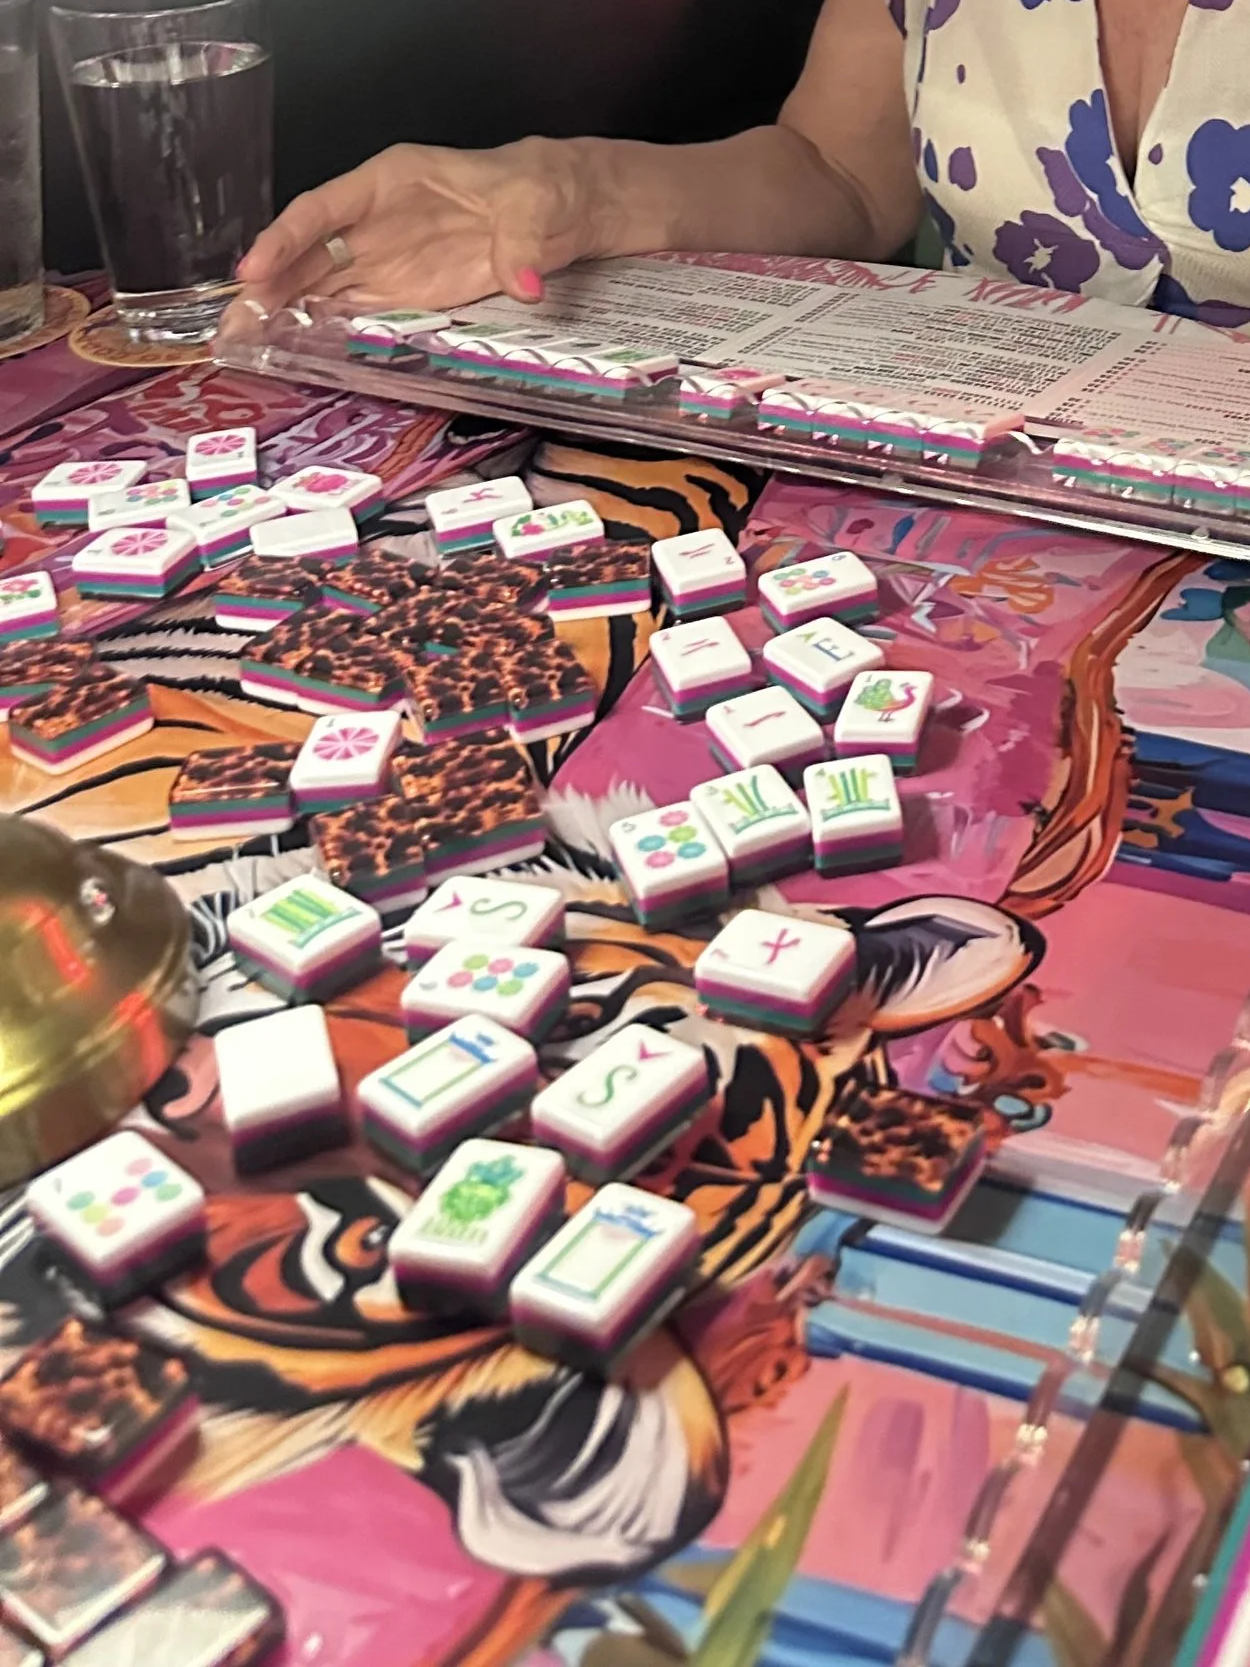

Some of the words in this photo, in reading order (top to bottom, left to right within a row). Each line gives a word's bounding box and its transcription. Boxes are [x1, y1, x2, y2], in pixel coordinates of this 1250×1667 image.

[814, 637, 855, 662] E
[470, 897, 527, 921] S
[577, 1064, 638, 1108] S
